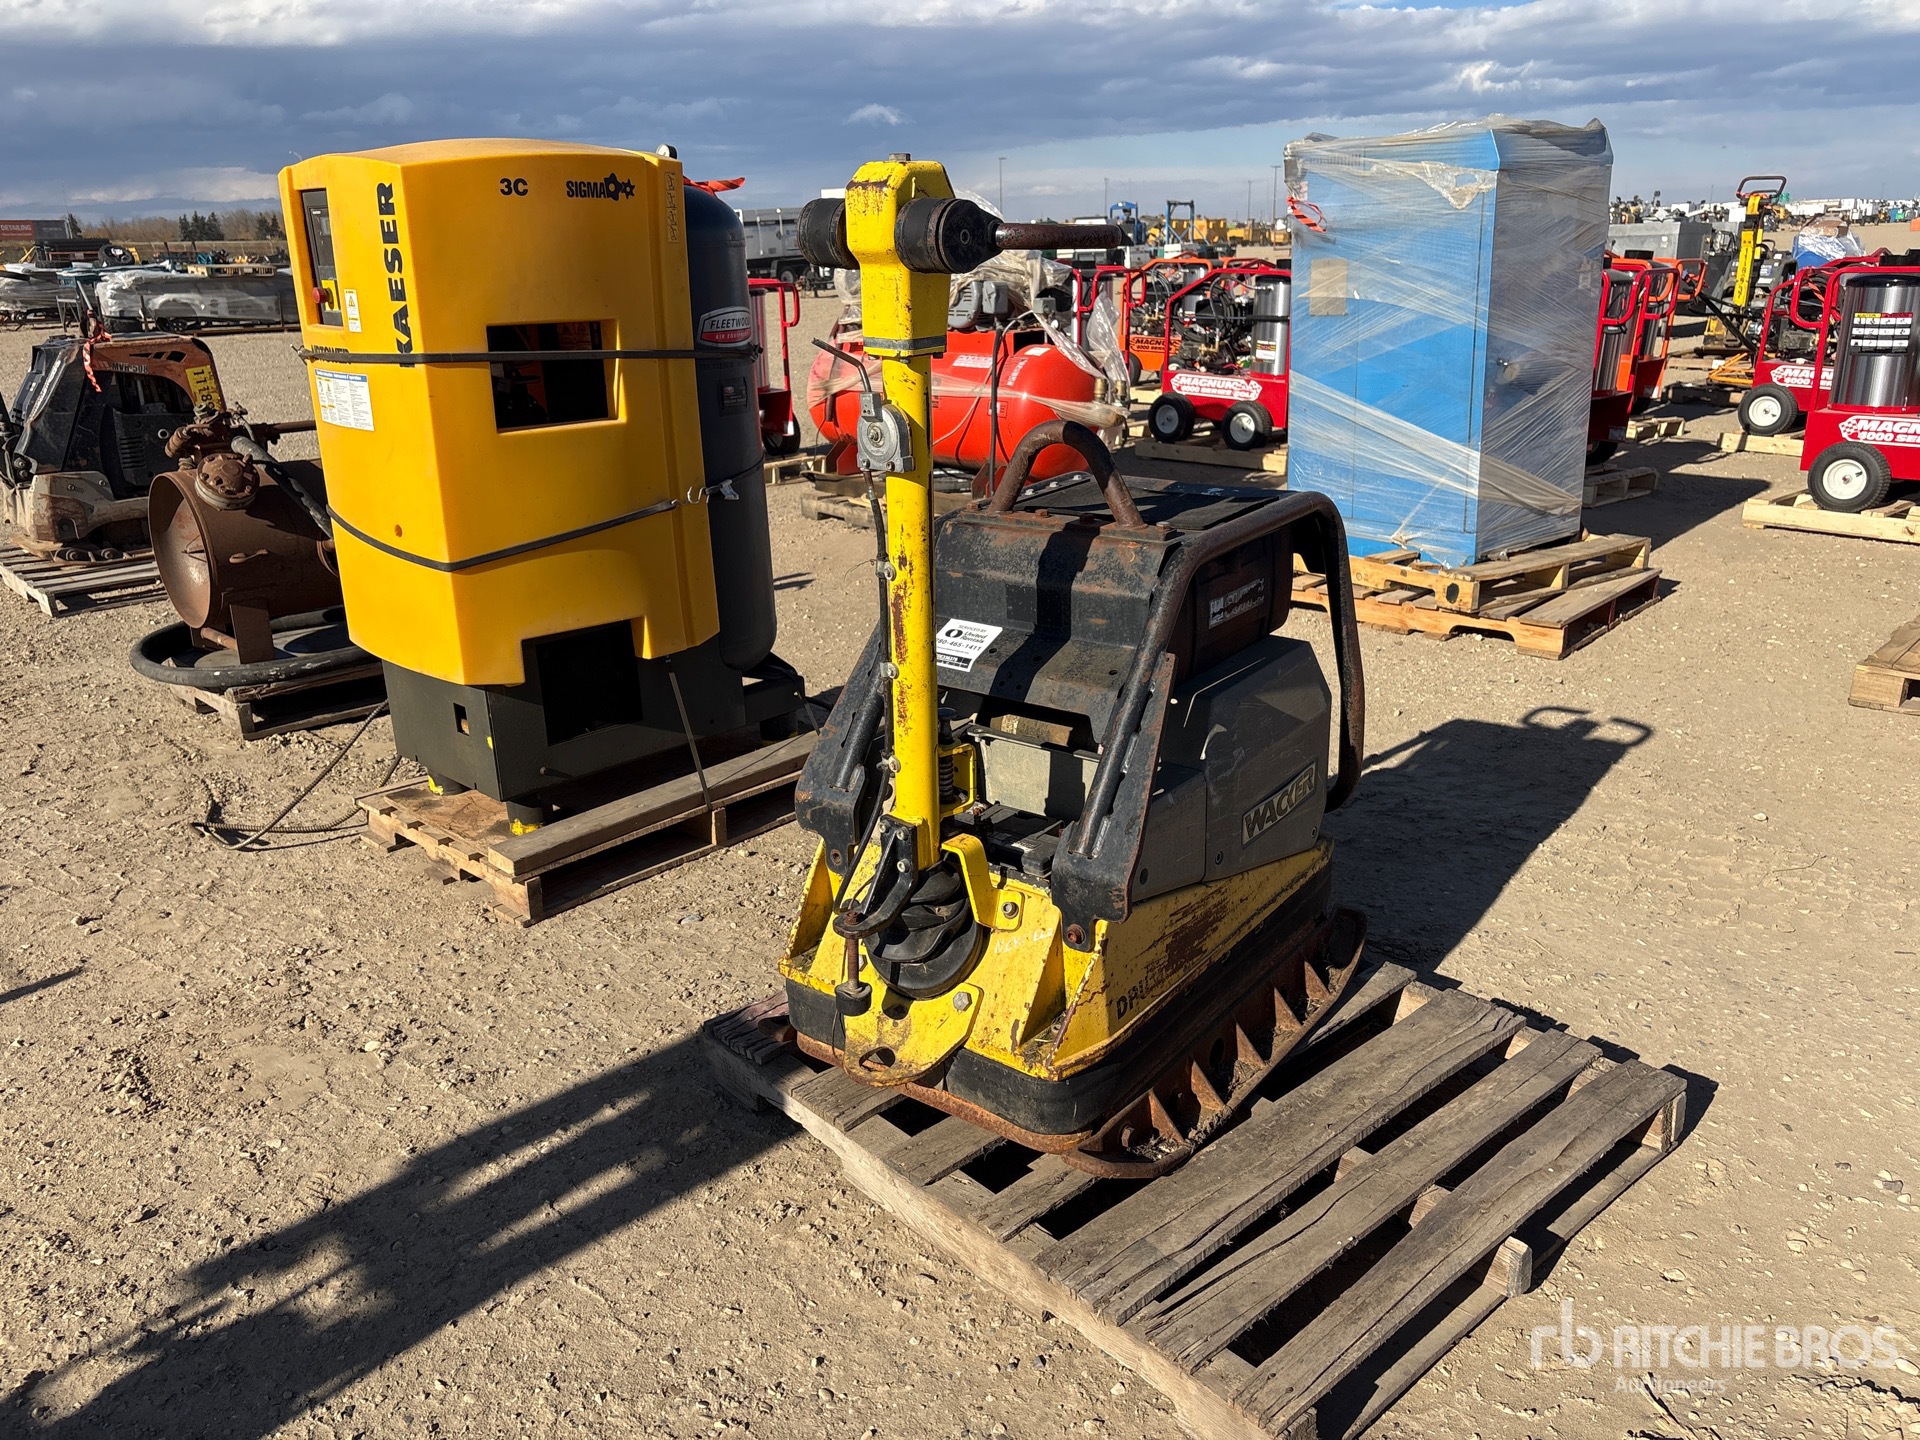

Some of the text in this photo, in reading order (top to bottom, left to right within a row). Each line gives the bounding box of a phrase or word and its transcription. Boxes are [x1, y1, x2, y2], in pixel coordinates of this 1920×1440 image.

[499, 178, 528, 196] 3C
[566, 180, 606, 198] SIGMA
[377, 182, 415, 368] KAESER
[710, 317, 751, 332] FLEETWOO
[1180, 376, 1236, 390] MAGNUM
[1857, 419, 1920, 434] MAGN
[960, 635, 984, 643] Rentals
[964, 630, 989, 639] United
[936, 638, 982, 651] 80-465-1411
[1245, 767, 1314, 839] WACKER
